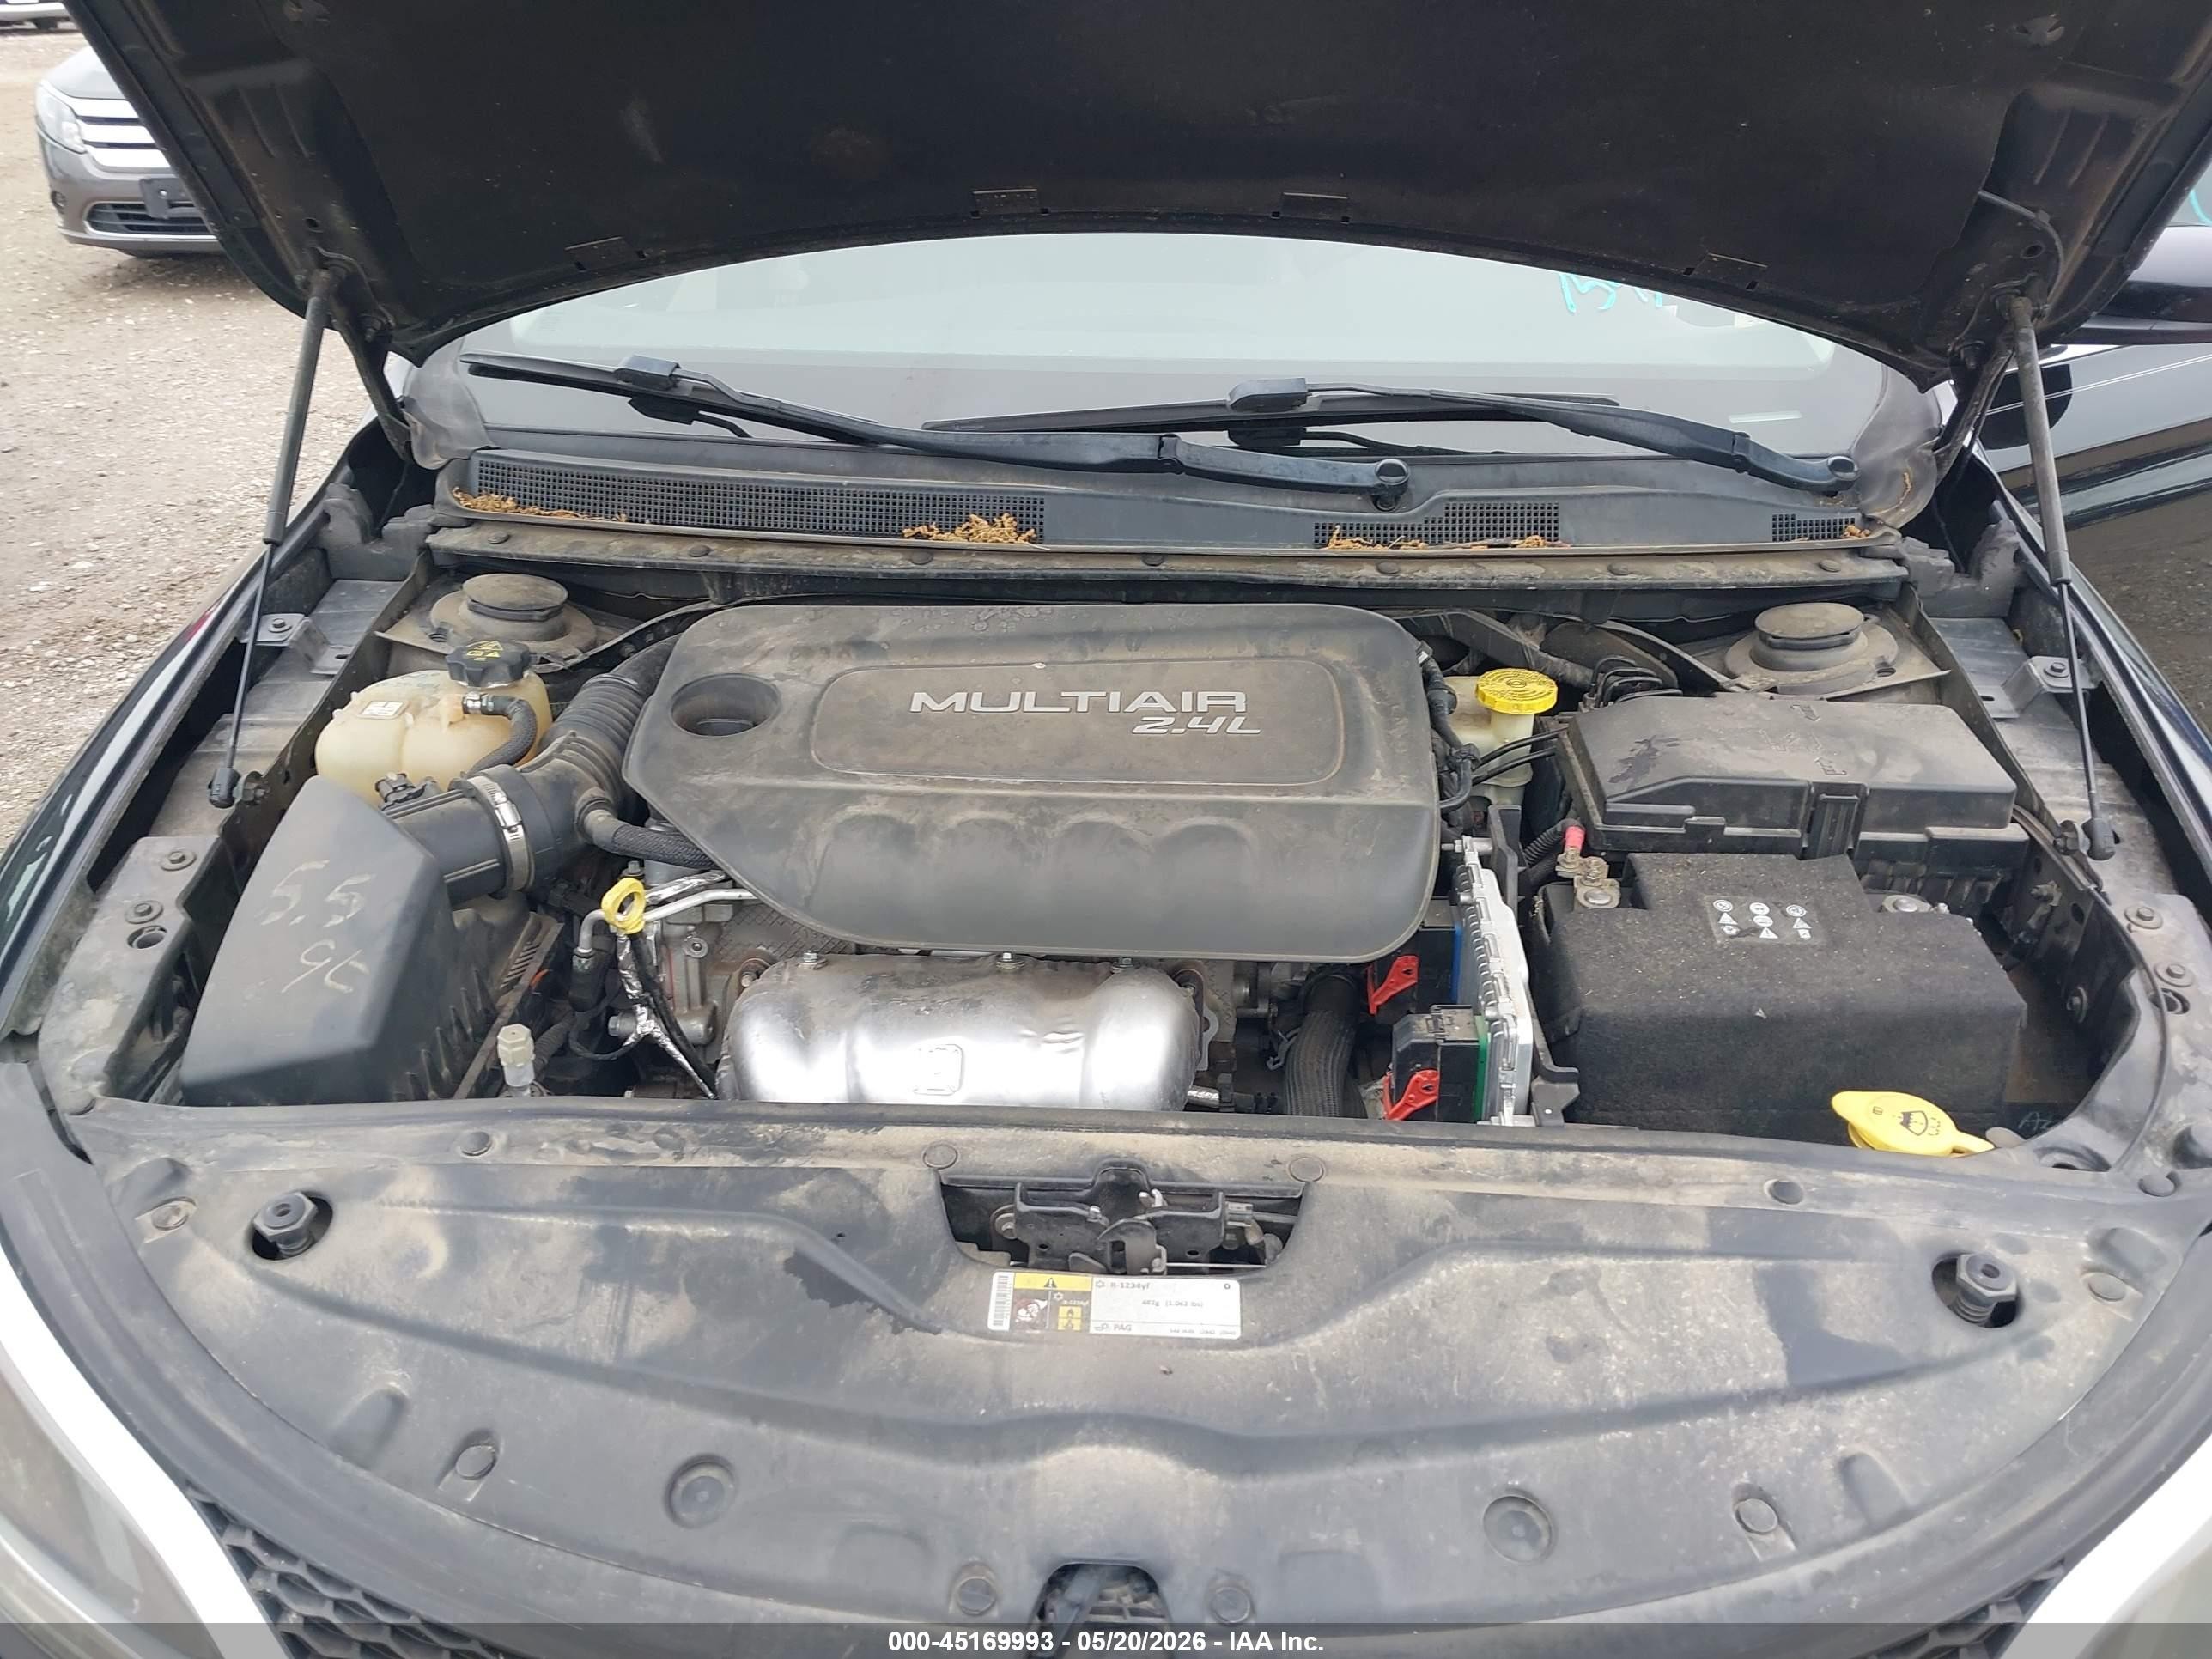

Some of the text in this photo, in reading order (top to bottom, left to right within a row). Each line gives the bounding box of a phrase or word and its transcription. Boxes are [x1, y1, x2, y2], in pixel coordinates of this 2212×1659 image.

[909, 690, 1247, 714] MULTIAIR
[1132, 715, 1261, 735] 2.4L
[1113, 1323, 1133, 1332] PAG
